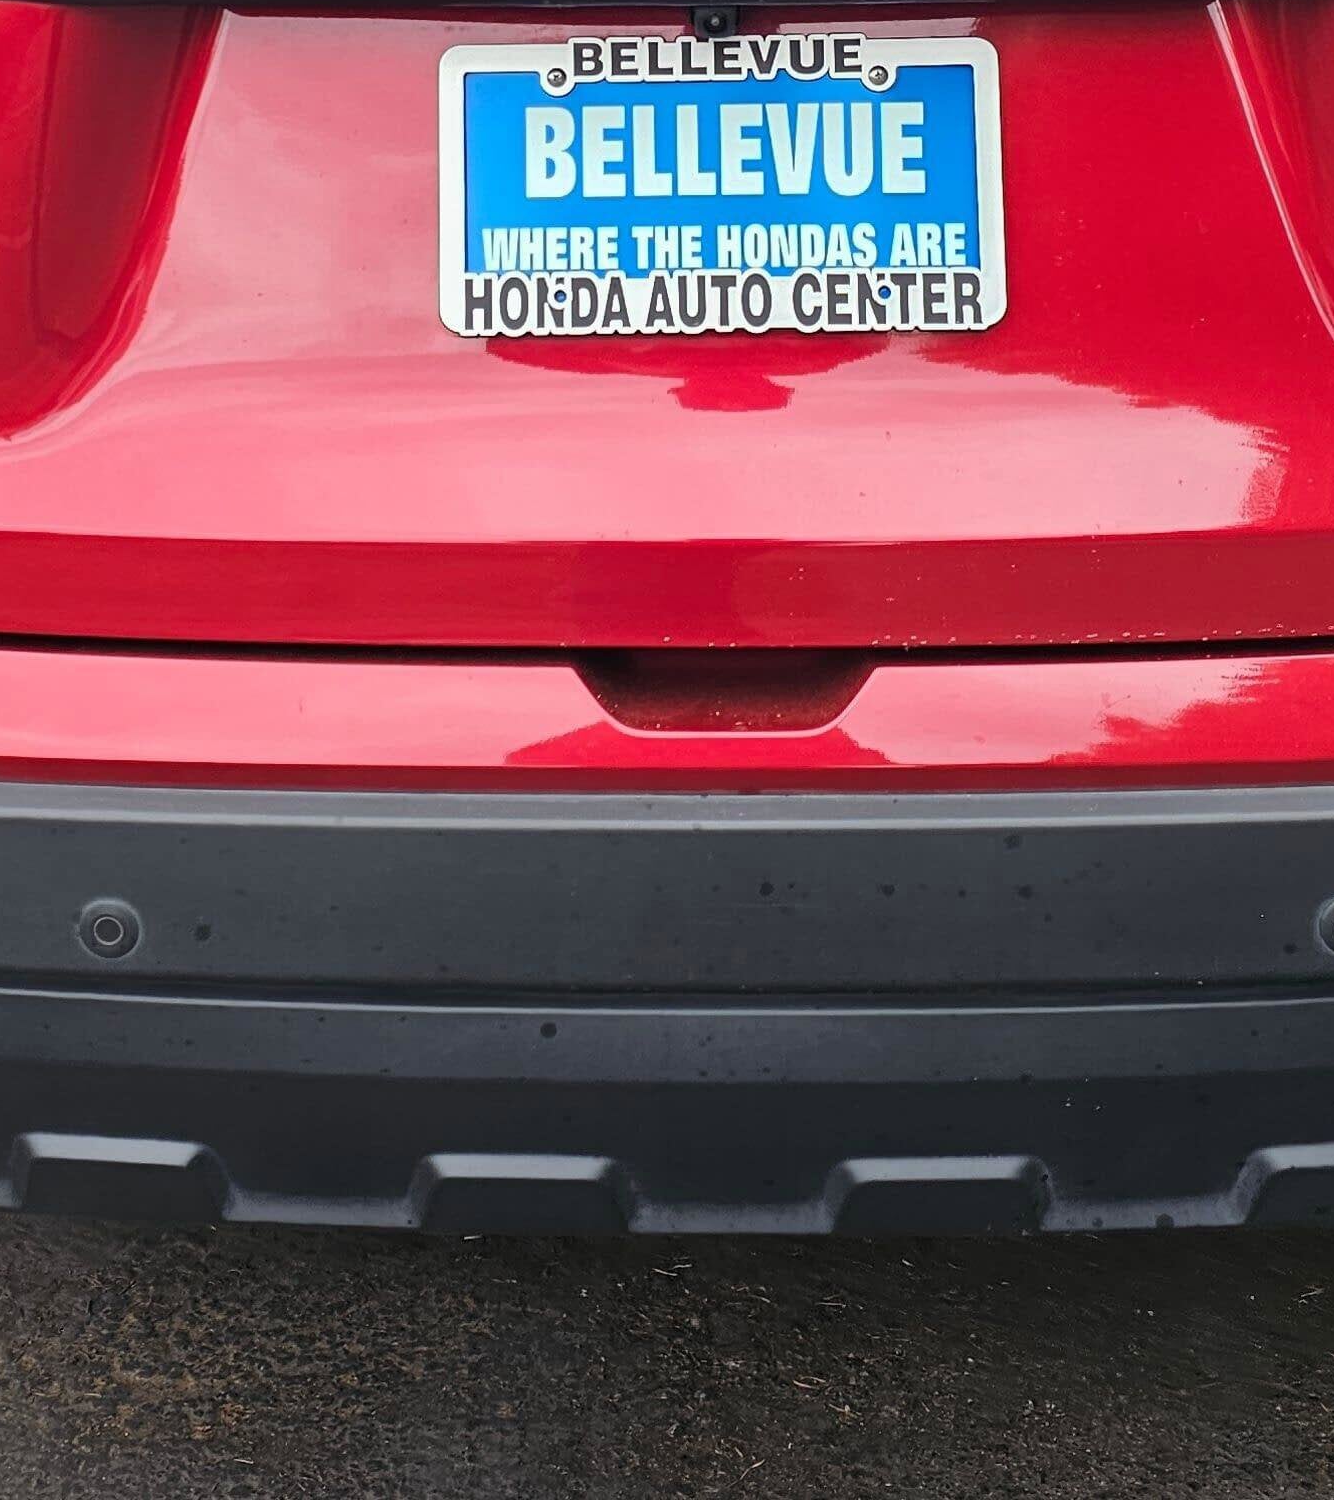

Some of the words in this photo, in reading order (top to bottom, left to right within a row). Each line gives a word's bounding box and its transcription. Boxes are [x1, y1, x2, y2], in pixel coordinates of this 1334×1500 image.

[572, 38, 863, 76] BELLEVUE
[525, 101, 926, 198] BELLEVUE
[482, 226, 619, 270] WHERE
[632, 225, 703, 269] THE
[716, 223, 878, 268] HONDAS
[890, 222, 966, 267] ARE
[465, 272, 632, 330] HONDA
[645, 272, 773, 328] AUTO
[792, 271, 984, 327] CENTER
